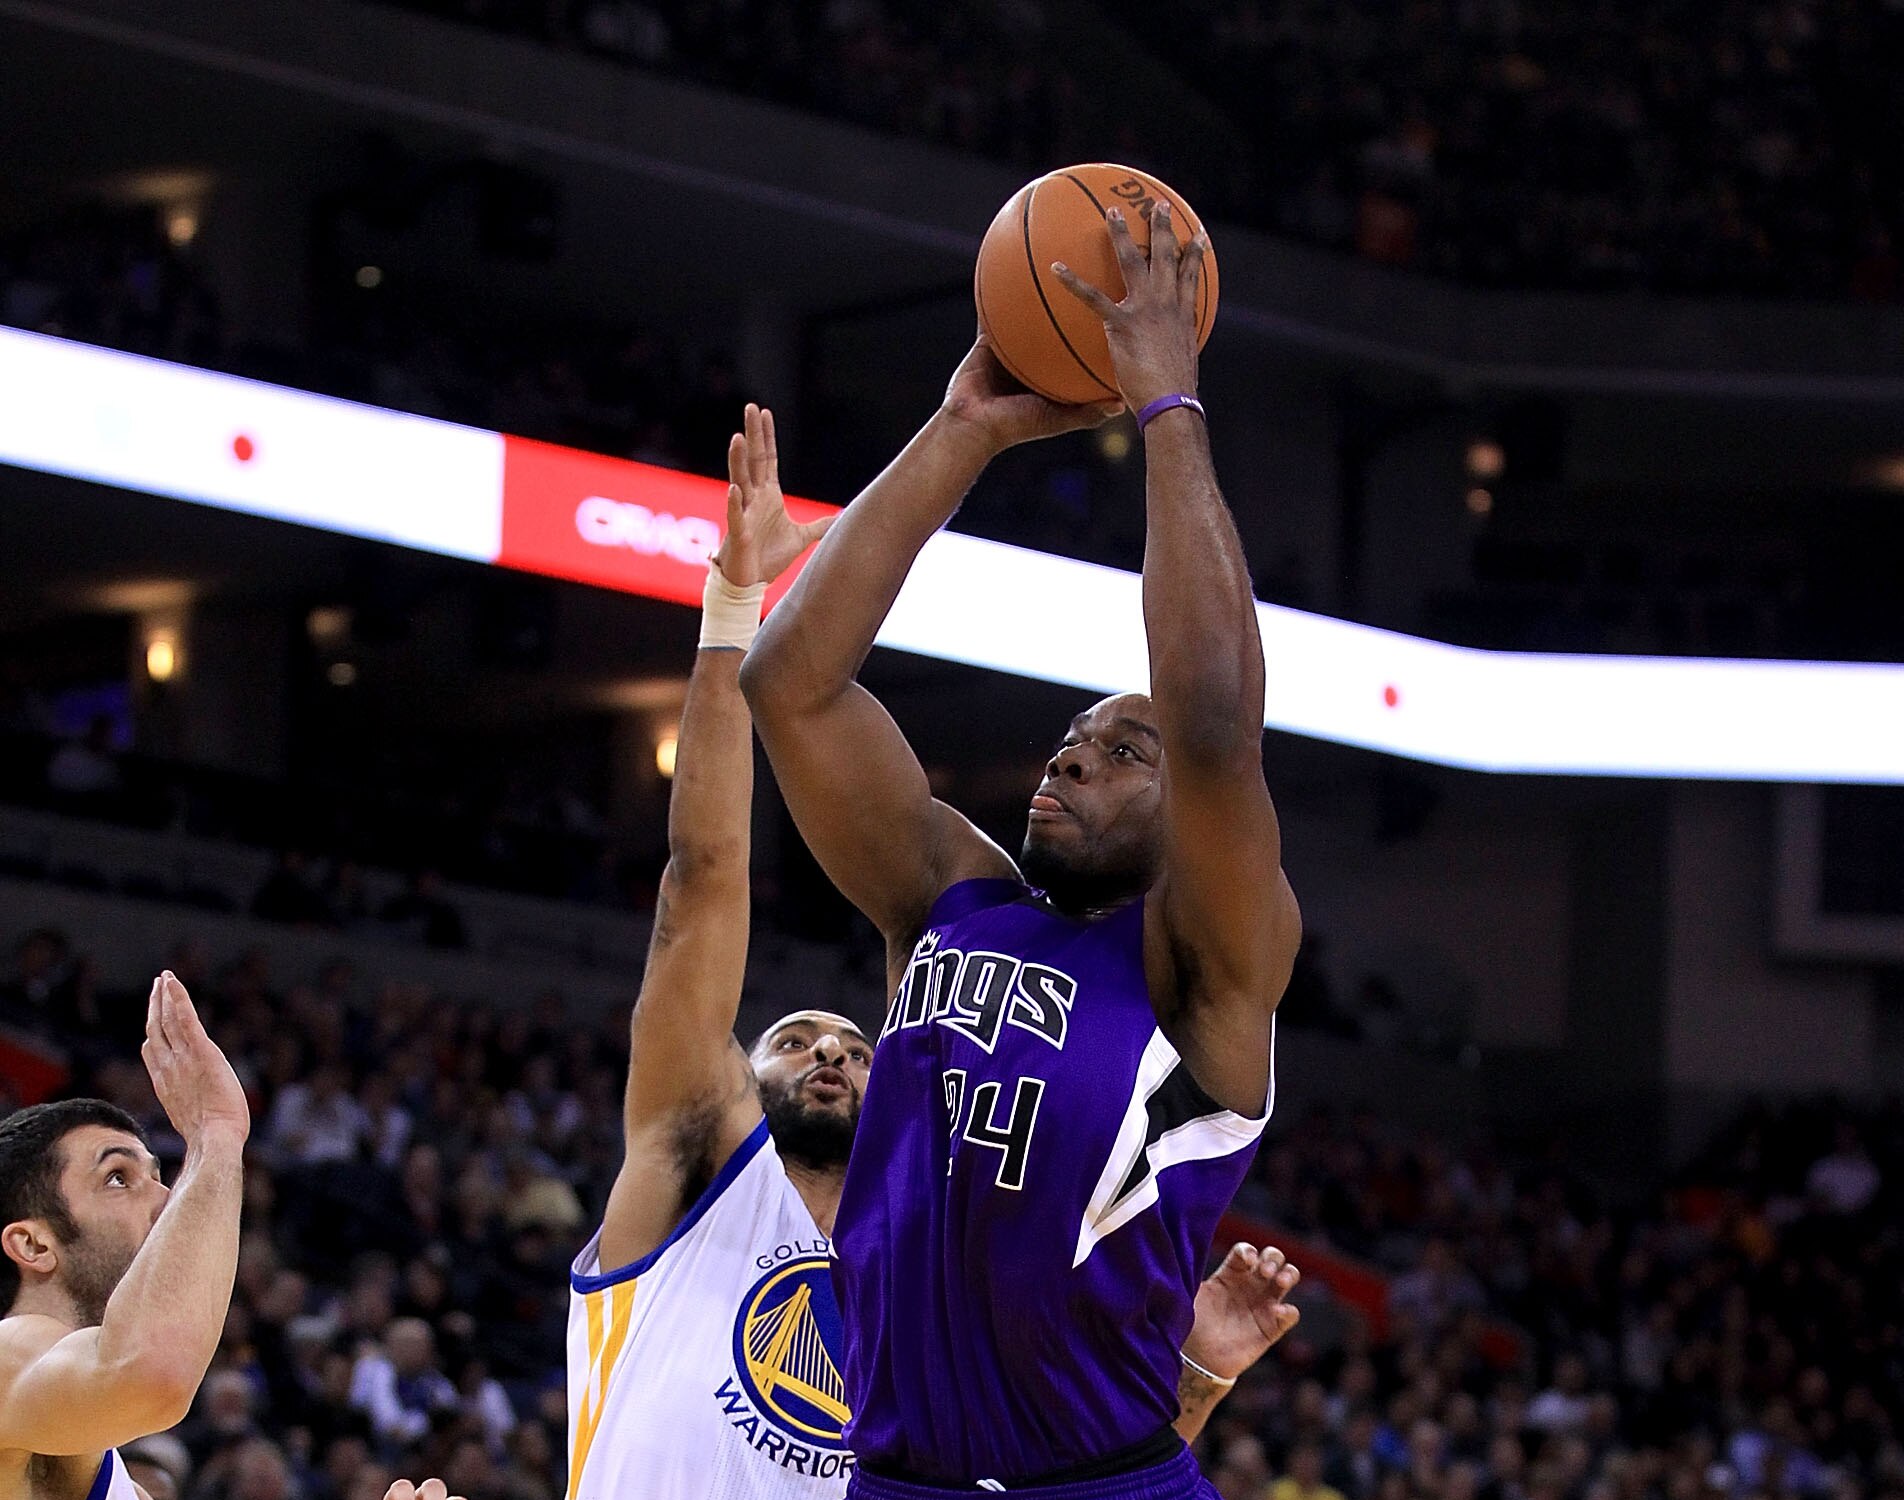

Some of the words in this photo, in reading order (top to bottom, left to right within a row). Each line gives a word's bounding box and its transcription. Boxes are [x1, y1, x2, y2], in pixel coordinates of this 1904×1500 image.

[876, 930, 1077, 1055] ings
[756, 1239, 829, 1270] GOLD
[713, 1376, 857, 1479] WARRIOR
